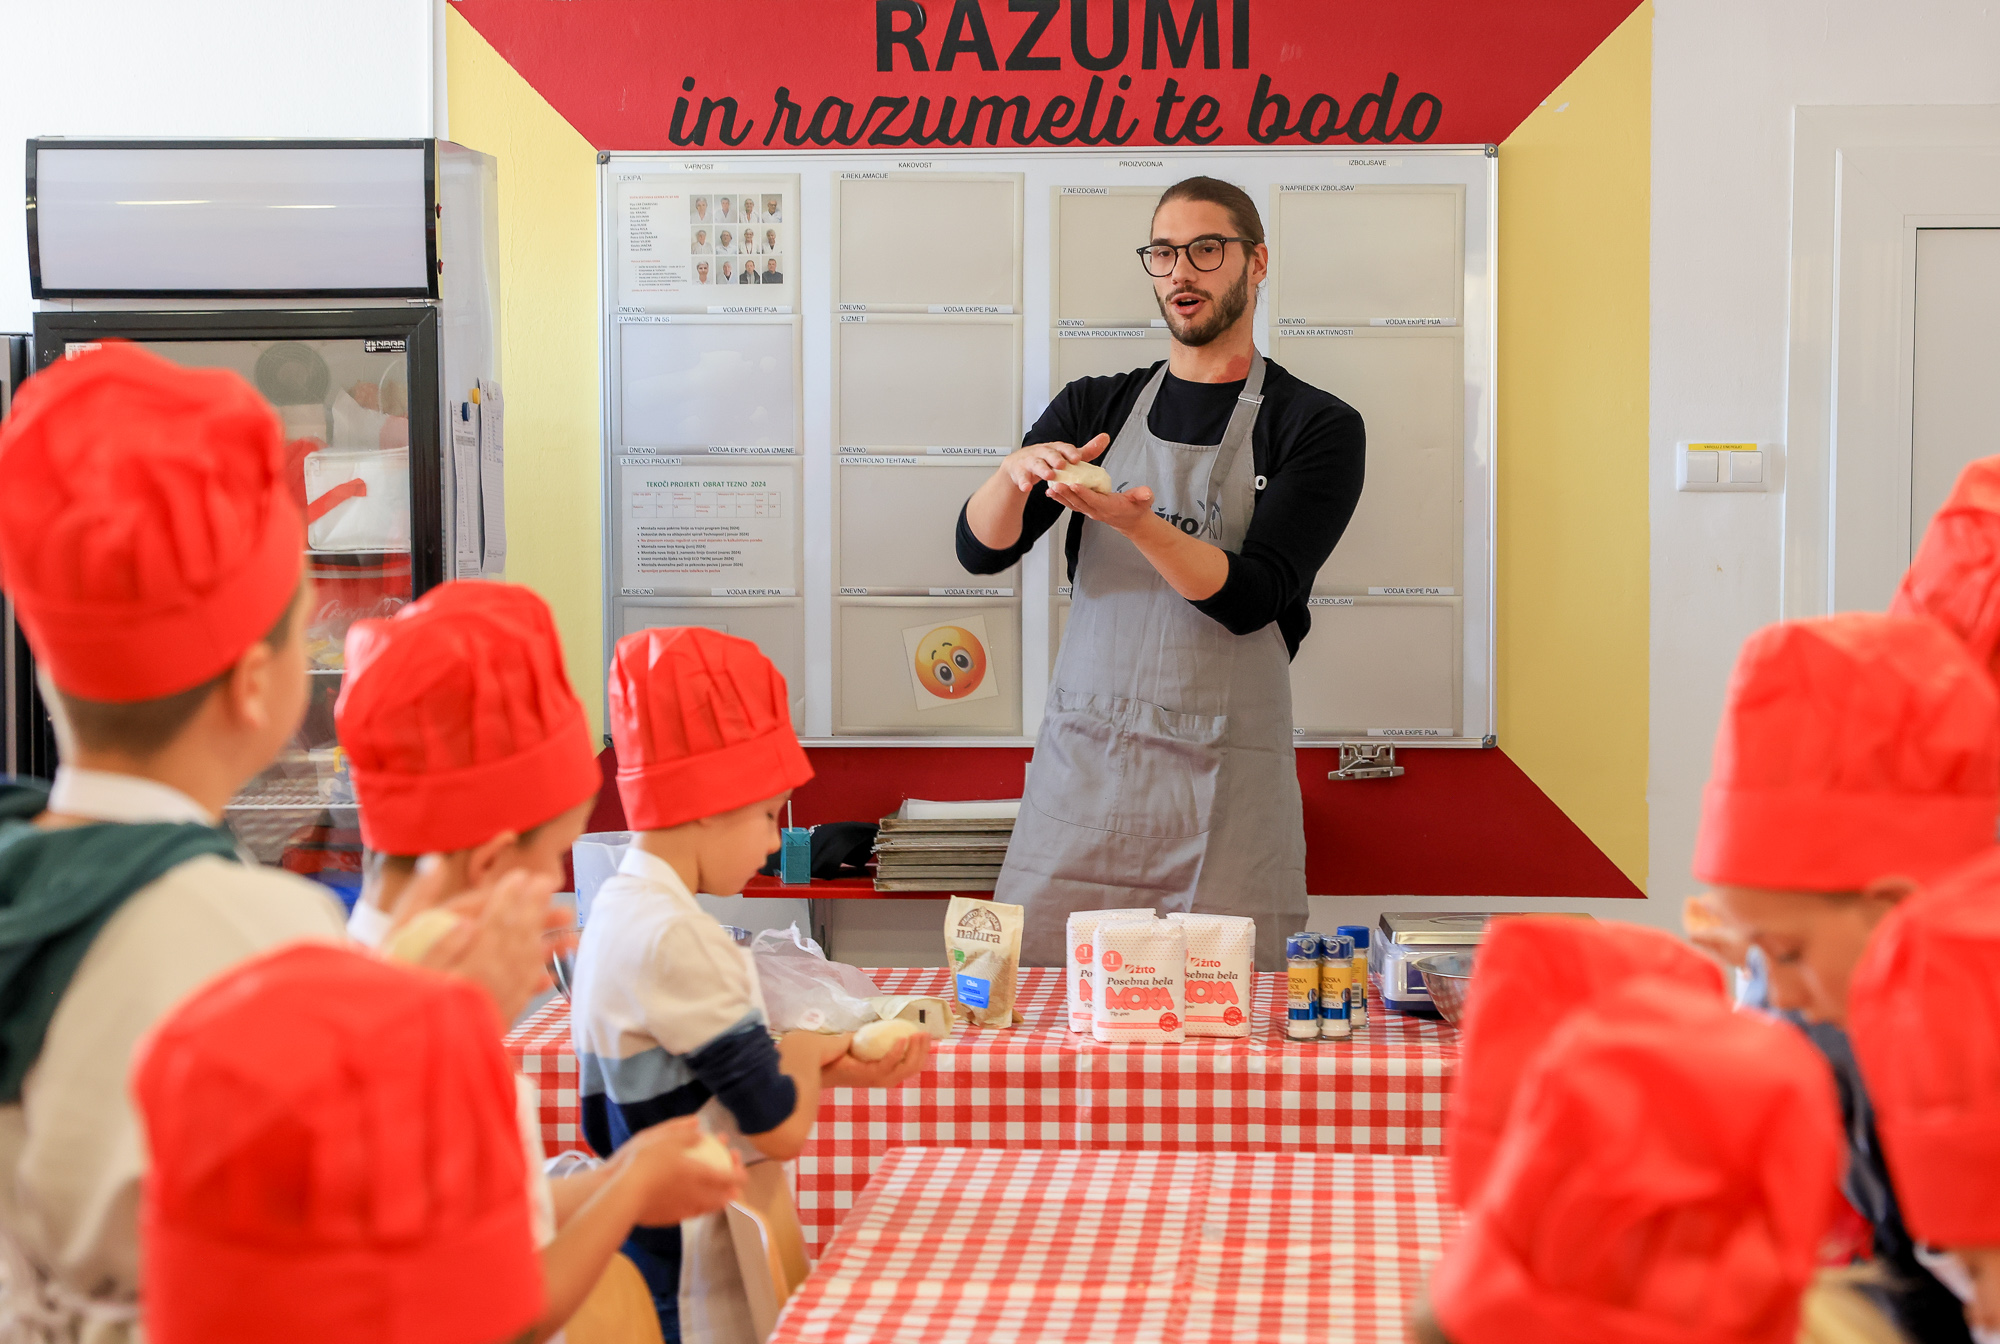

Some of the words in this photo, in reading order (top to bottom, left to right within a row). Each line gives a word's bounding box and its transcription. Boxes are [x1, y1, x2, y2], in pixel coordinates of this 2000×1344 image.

[876, 0, 1250, 72] RAZUMI
[669, 77, 754, 147] in
[763, 75, 1140, 147] razumeli
[1153, 77, 1224, 146] te
[1247, 72, 1443, 146] bodo
[1057, 319, 1085, 327] DNEVNO
[646, 480, 669, 488] TEKOČI
[956, 927, 1001, 944] natura
[1201, 959, 1222, 968] žito
[1135, 966, 1156, 974] žito
[1186, 970, 1215, 979] sebna
[1217, 970, 1238, 979] bela
[1107, 977, 1150, 986] Posebna
[1152, 976, 1174, 986] bela
[1105, 986, 1175, 1011] MOKA
